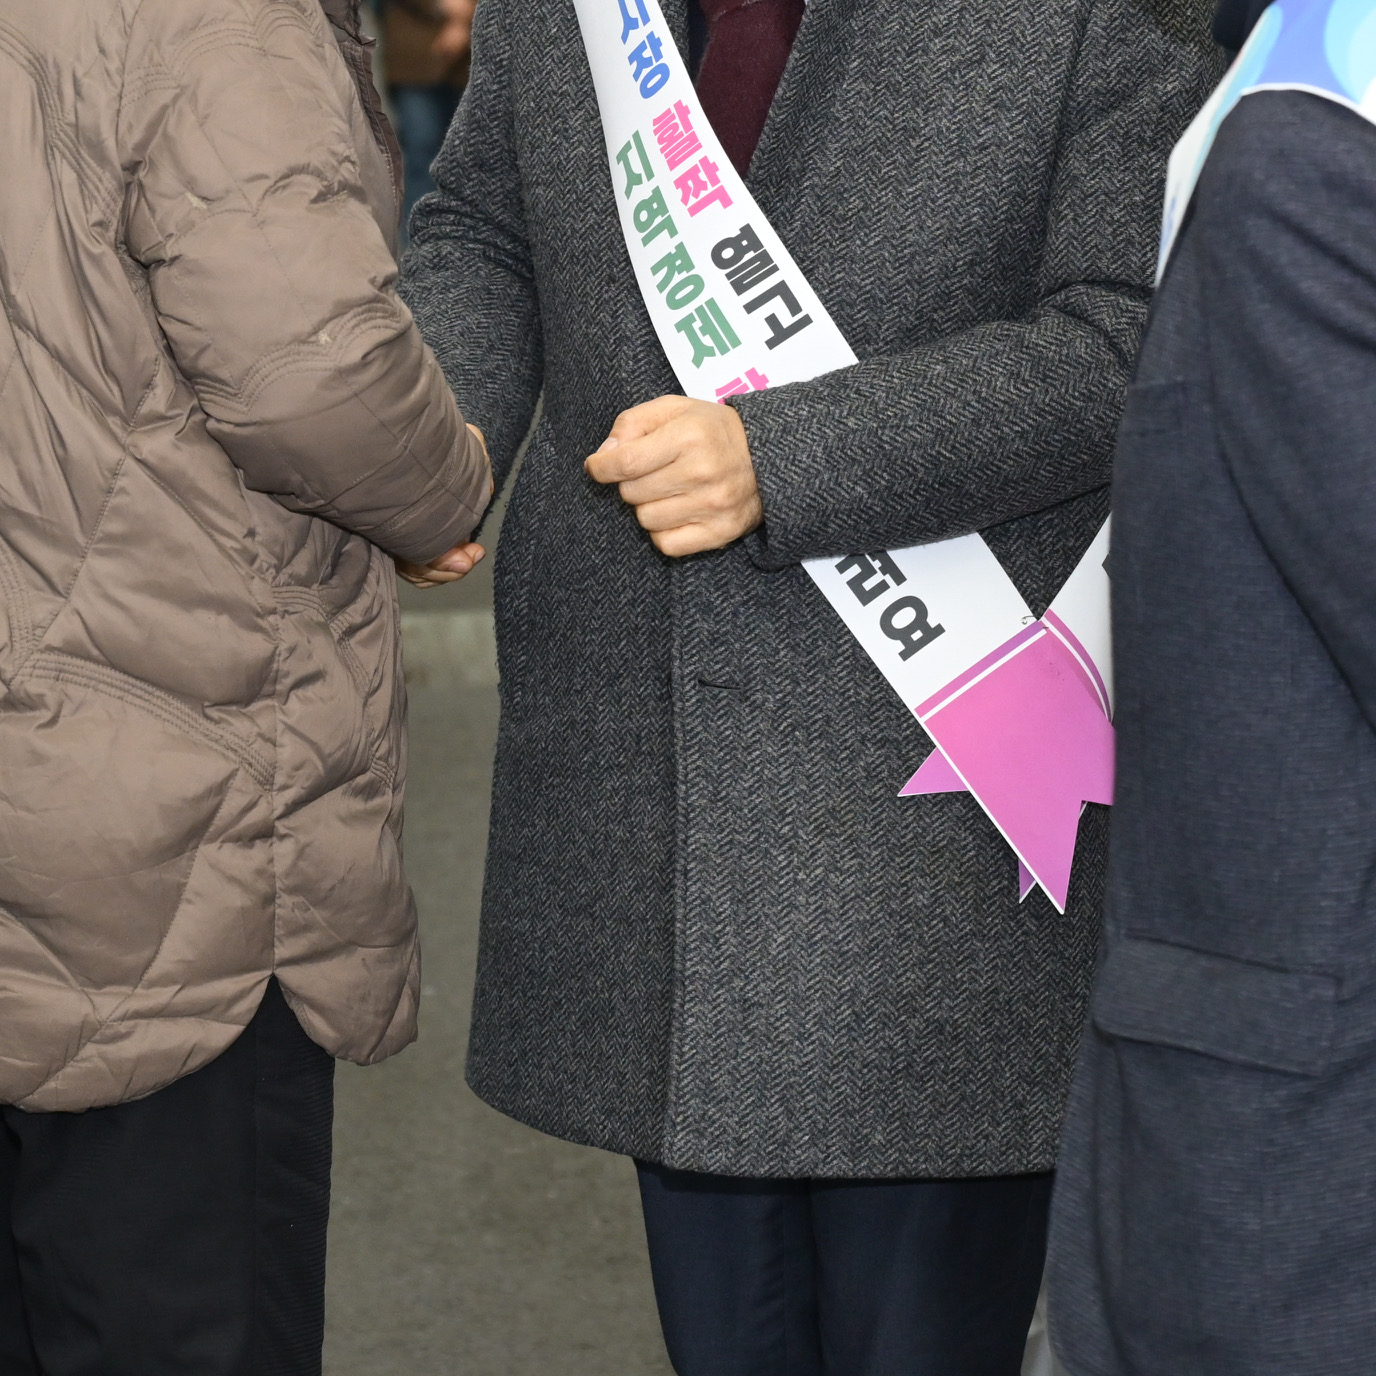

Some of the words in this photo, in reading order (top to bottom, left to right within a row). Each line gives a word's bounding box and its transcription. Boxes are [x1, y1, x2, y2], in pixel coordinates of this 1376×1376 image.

[614, 129, 742, 369] 지역경제
[651, 98, 735, 219] 활짝
[709, 222, 814, 352] 열고
